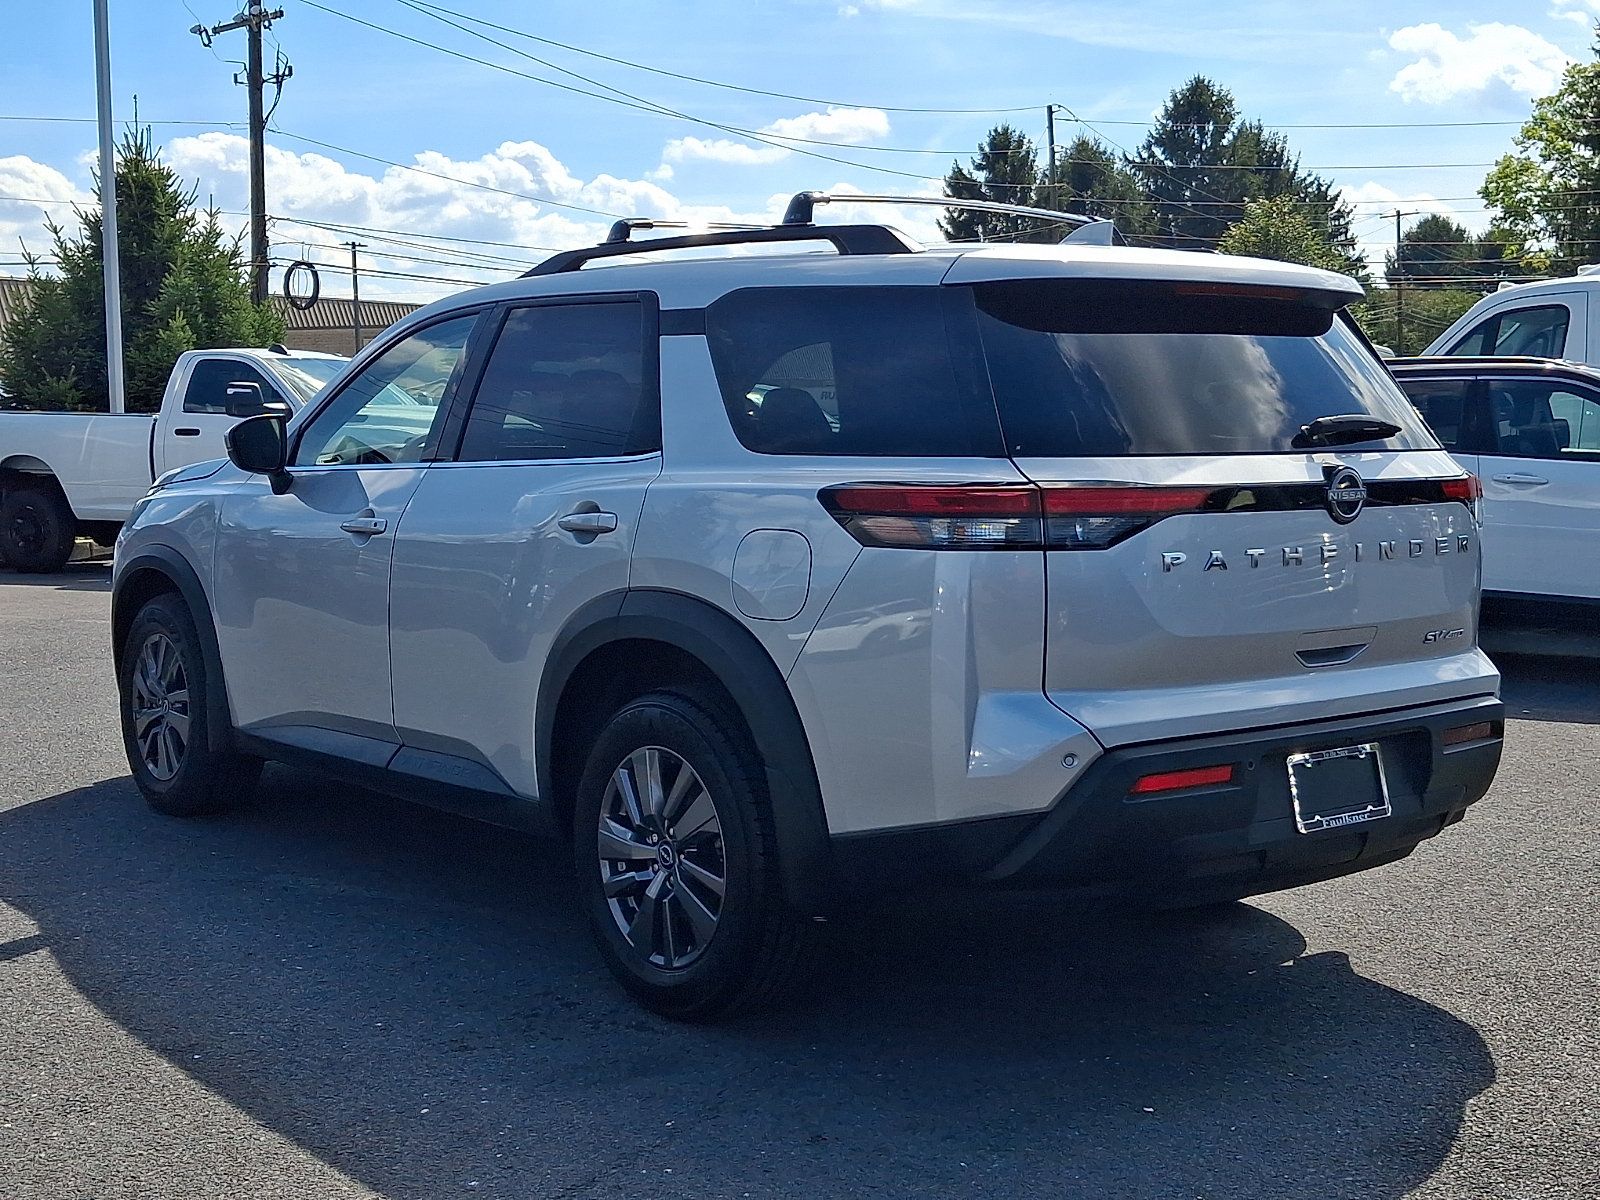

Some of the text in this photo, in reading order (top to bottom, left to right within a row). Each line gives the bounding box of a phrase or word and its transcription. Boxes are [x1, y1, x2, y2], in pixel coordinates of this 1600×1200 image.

[1329, 490, 1367, 500] NISSAN
[1161, 534, 1470, 573] PATHFINDER
[1322, 812, 1370, 828] Faulkner
